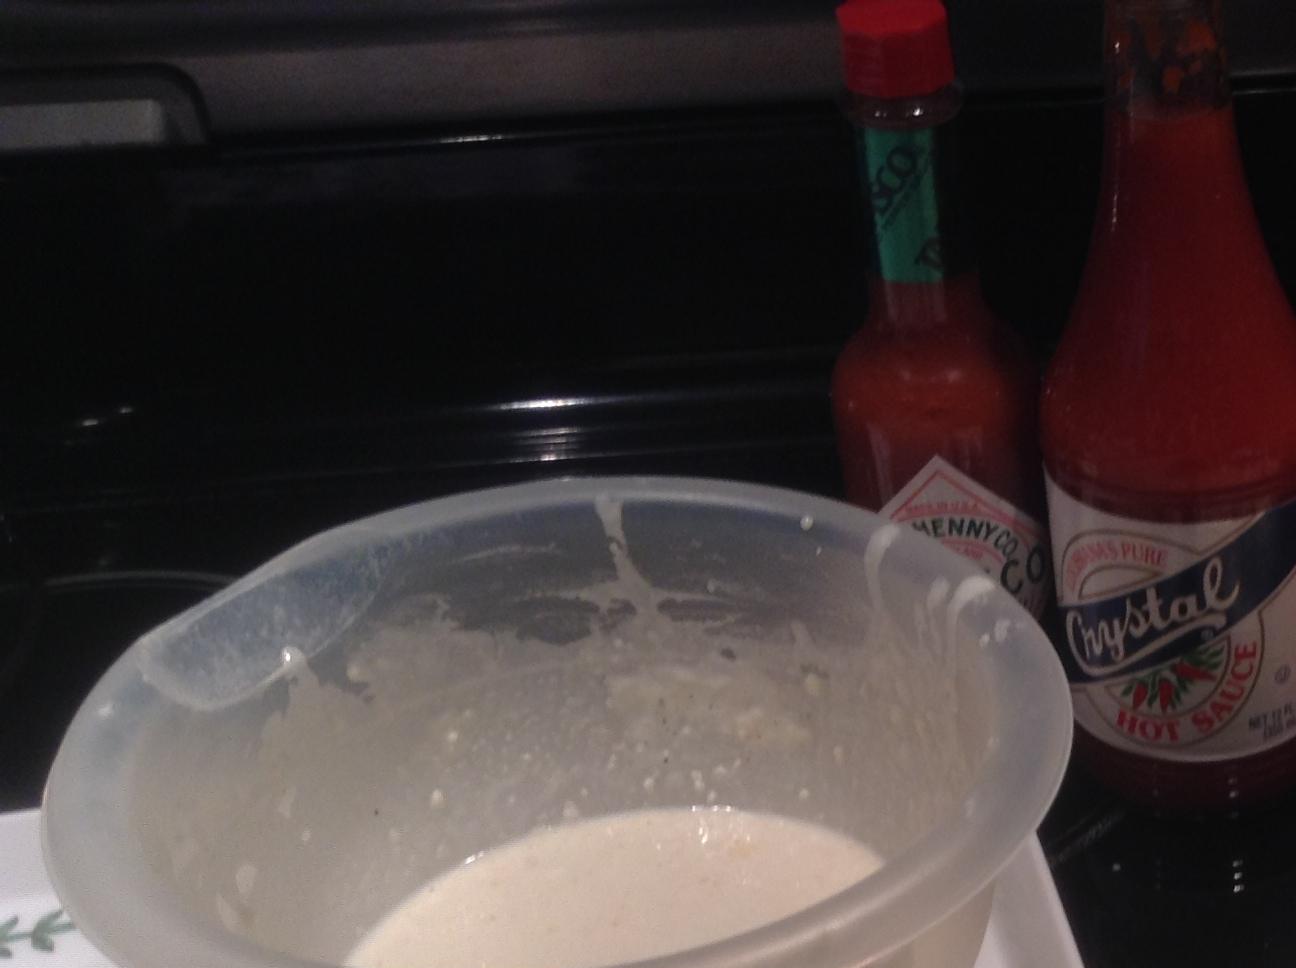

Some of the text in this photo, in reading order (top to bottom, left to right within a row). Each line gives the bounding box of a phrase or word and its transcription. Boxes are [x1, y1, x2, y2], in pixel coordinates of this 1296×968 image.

[912, 517, 999, 543] HENNY
[1121, 543, 1168, 569] PURE
[1065, 555, 1241, 676] Crystal
[1115, 707, 1182, 743] HOT
[1190, 640, 1258, 736] SAUCE
